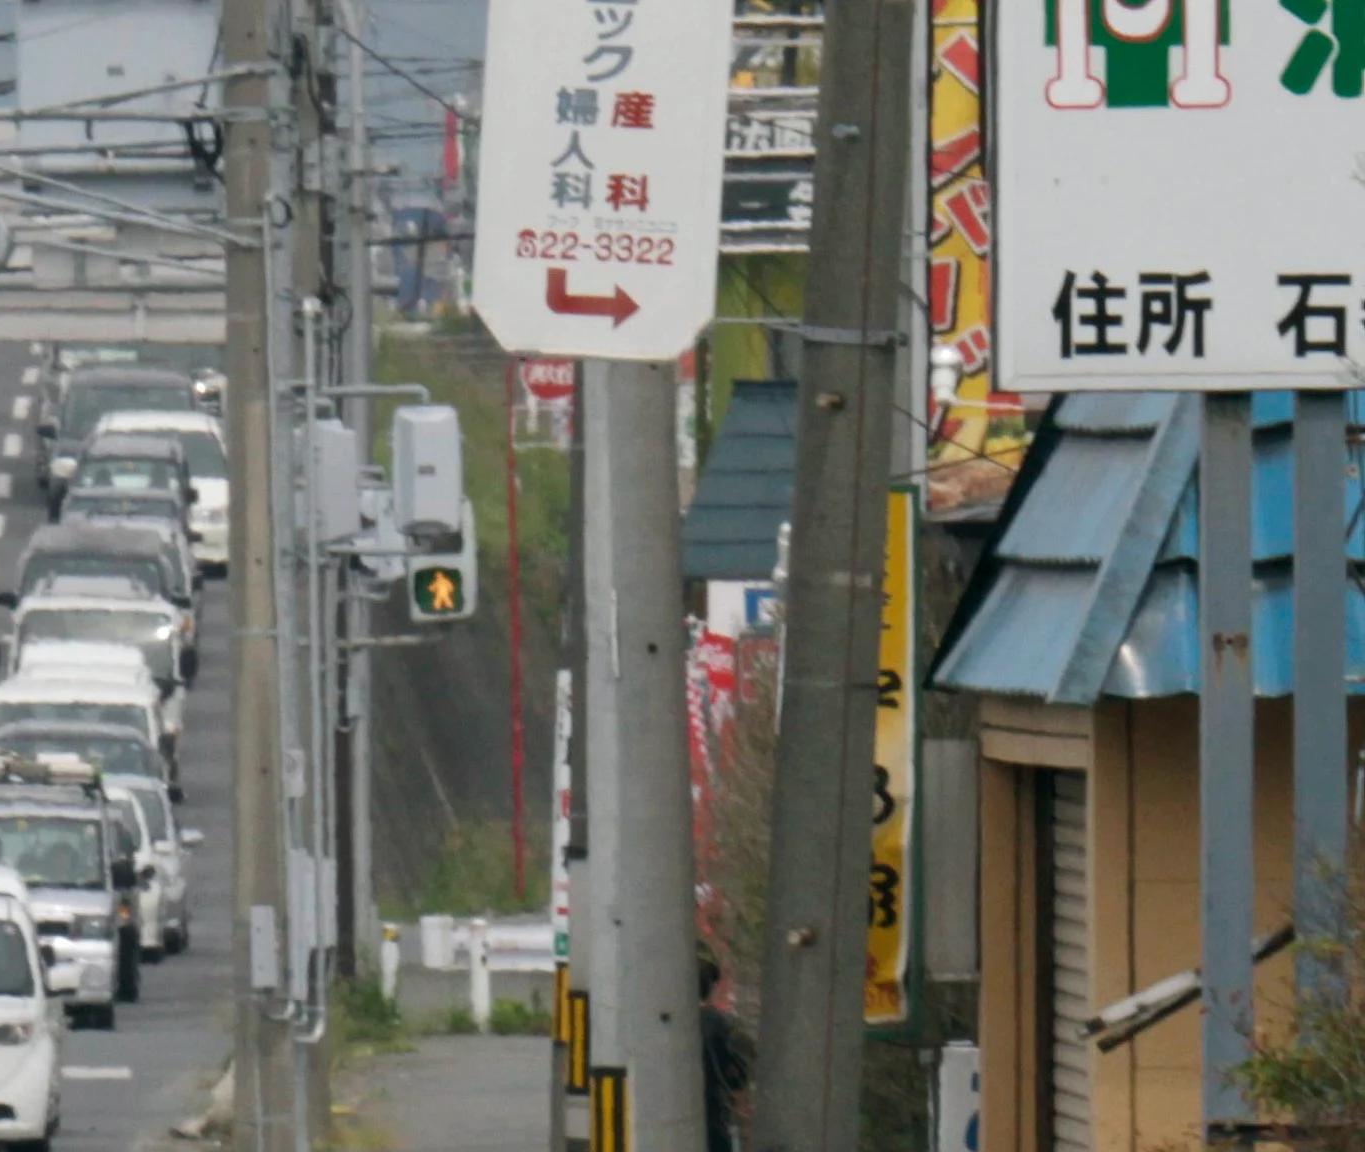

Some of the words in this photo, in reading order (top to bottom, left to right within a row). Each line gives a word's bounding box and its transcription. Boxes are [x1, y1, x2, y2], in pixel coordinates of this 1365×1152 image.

[583, 0, 639, 82] ック
[550, 85, 600, 211] 婦人科
[605, 91, 657, 213] 産科
[538, 230, 675, 266] 22-3322
[1052, 269, 1213, 360] 住所
[1275, 272, 1365, 359] 石
